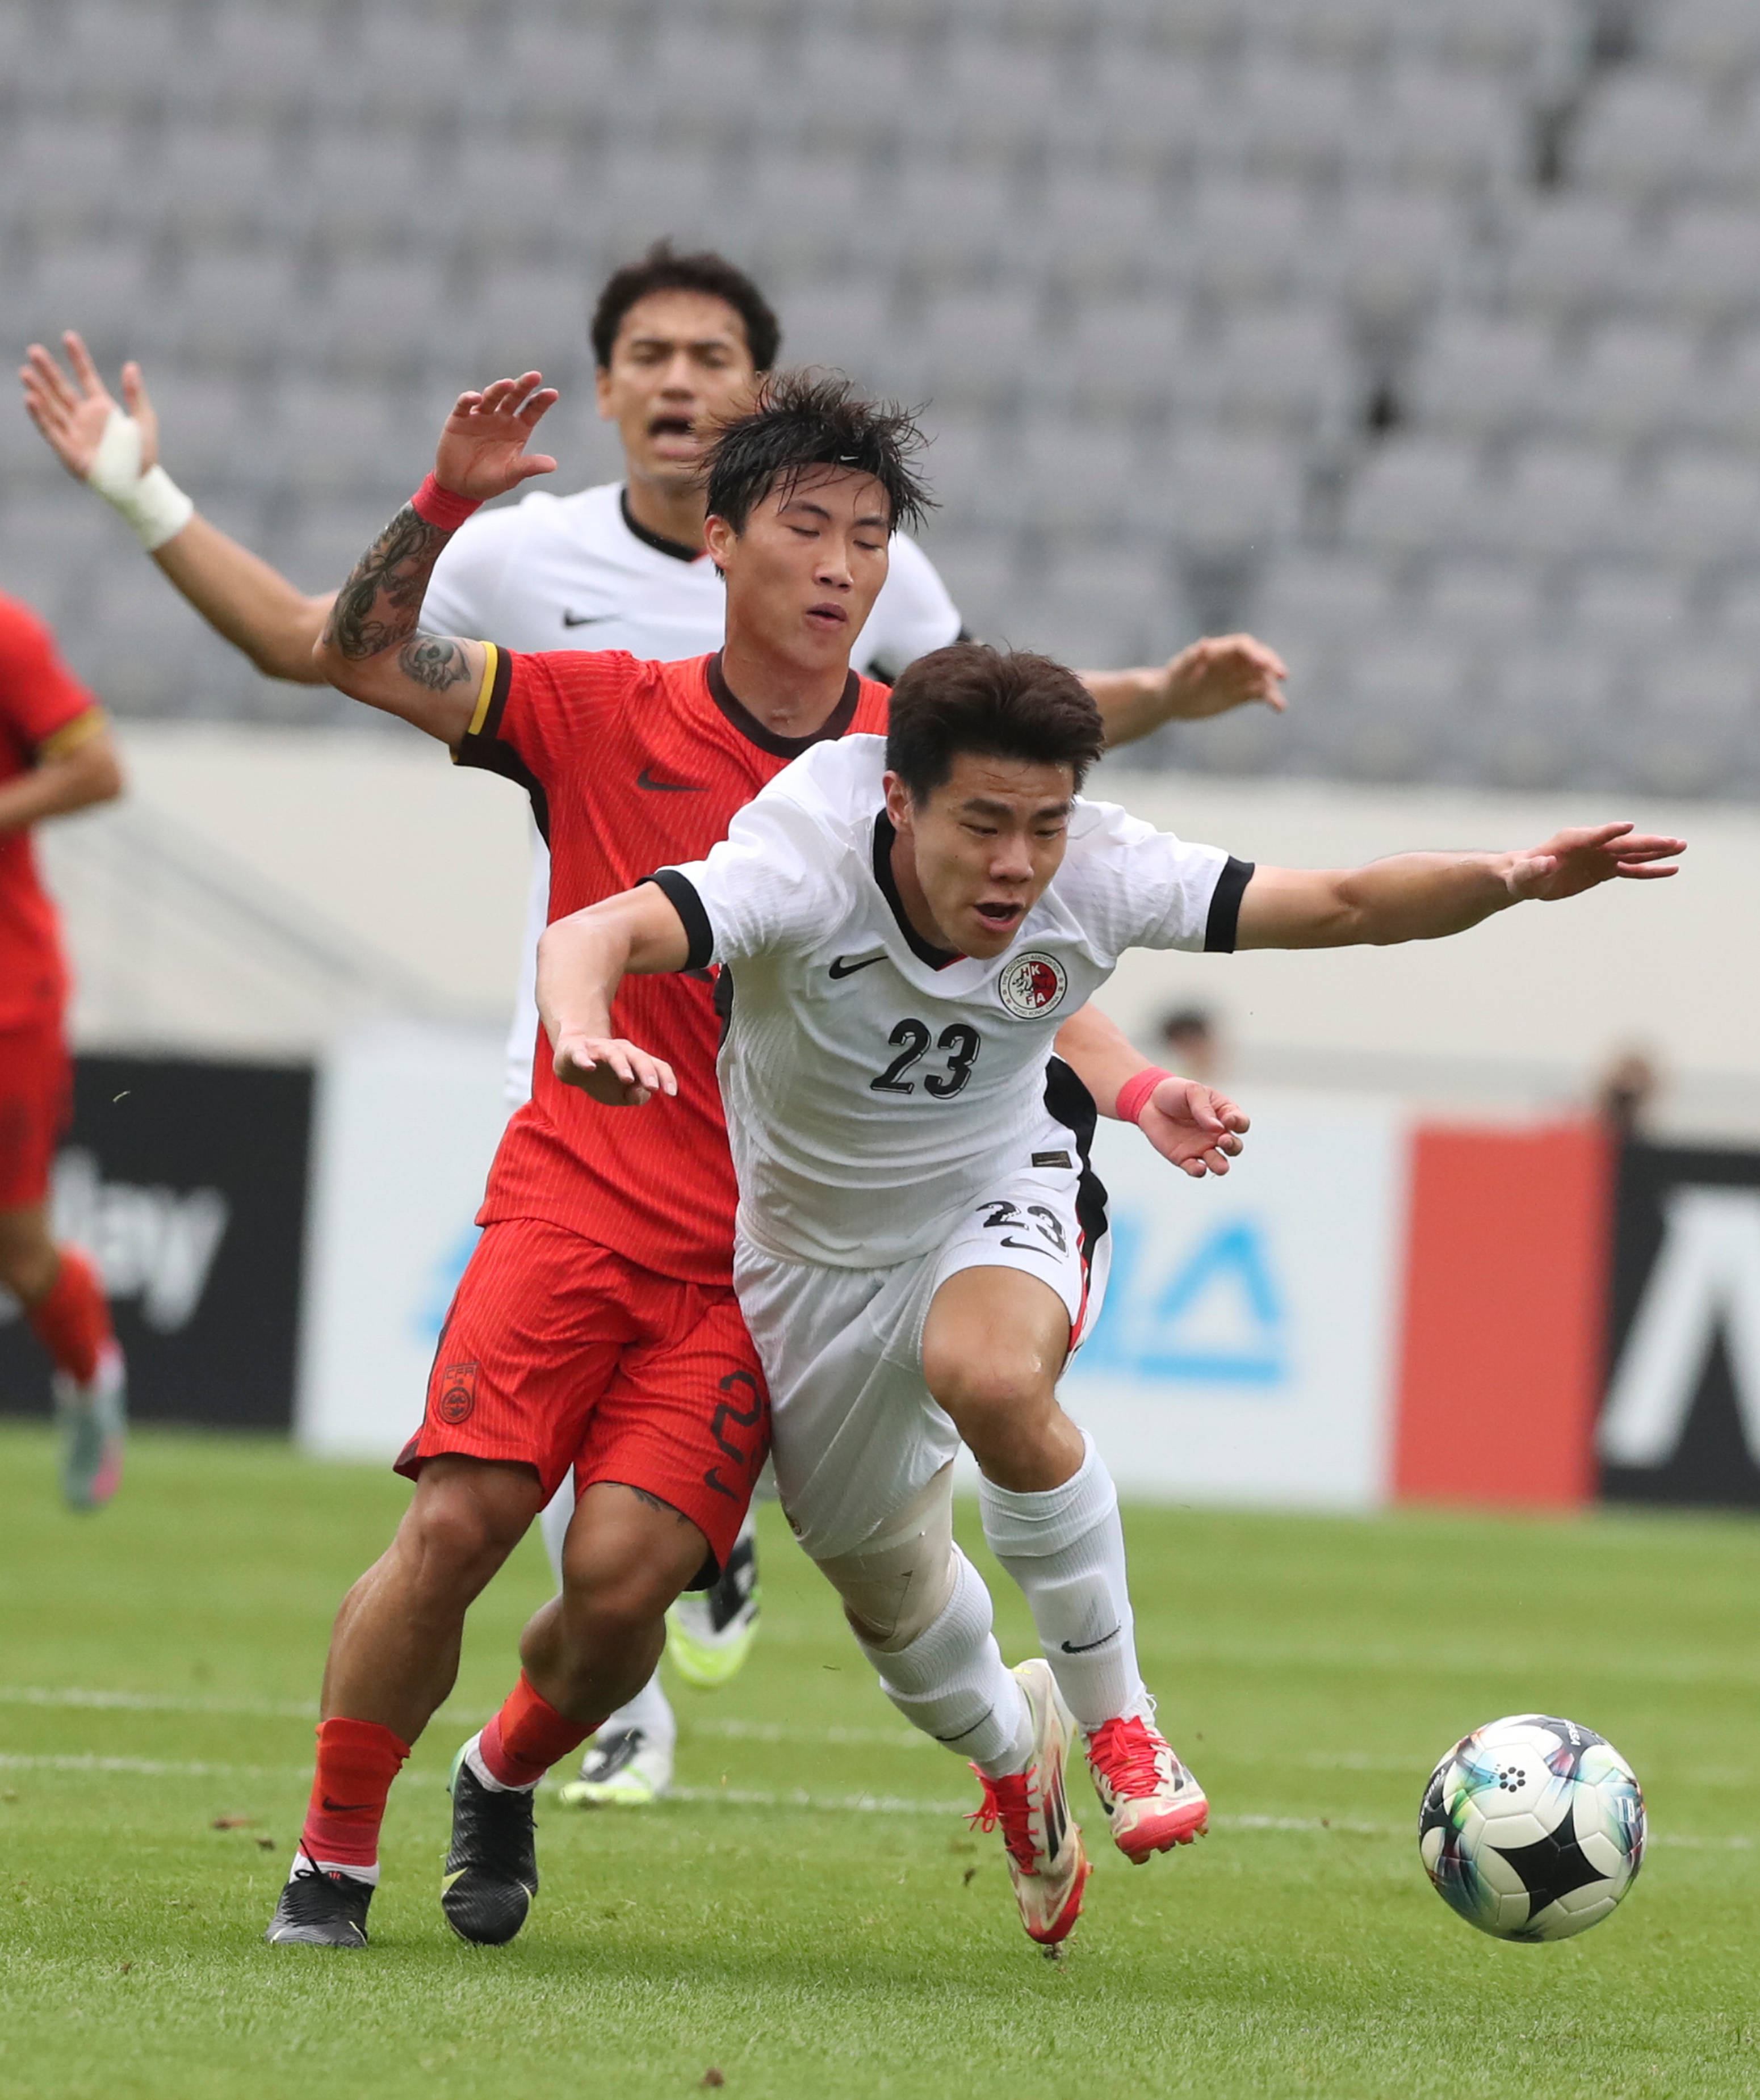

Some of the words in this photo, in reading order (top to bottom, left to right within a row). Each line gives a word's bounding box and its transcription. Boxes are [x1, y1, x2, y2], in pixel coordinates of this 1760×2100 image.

[1021, 965, 1041, 976] HK
[1026, 992, 1046, 1005] FA
[870, 1018, 981, 1100] 23
[975, 1200, 1070, 1258] 23
